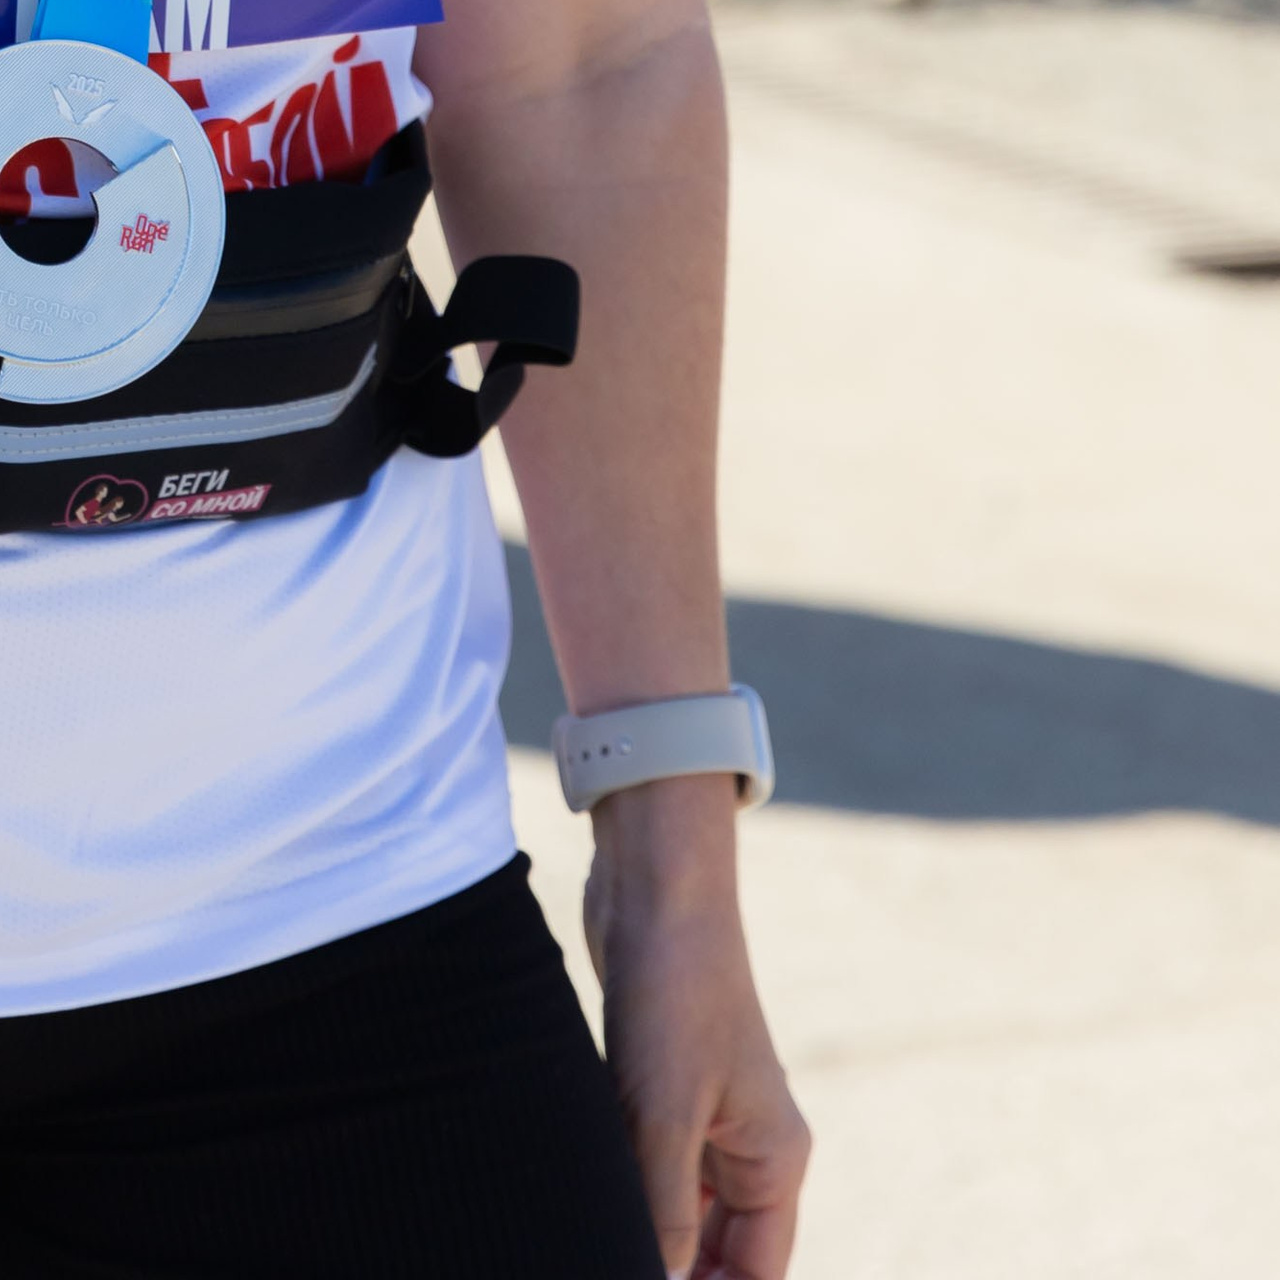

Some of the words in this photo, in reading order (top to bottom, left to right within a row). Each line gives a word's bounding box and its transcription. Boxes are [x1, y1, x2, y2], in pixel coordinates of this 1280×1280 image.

[159, 468, 230, 498] БЕГИ
[151, 503, 186, 519] СО
[187, 485, 266, 514] МНОЙ
